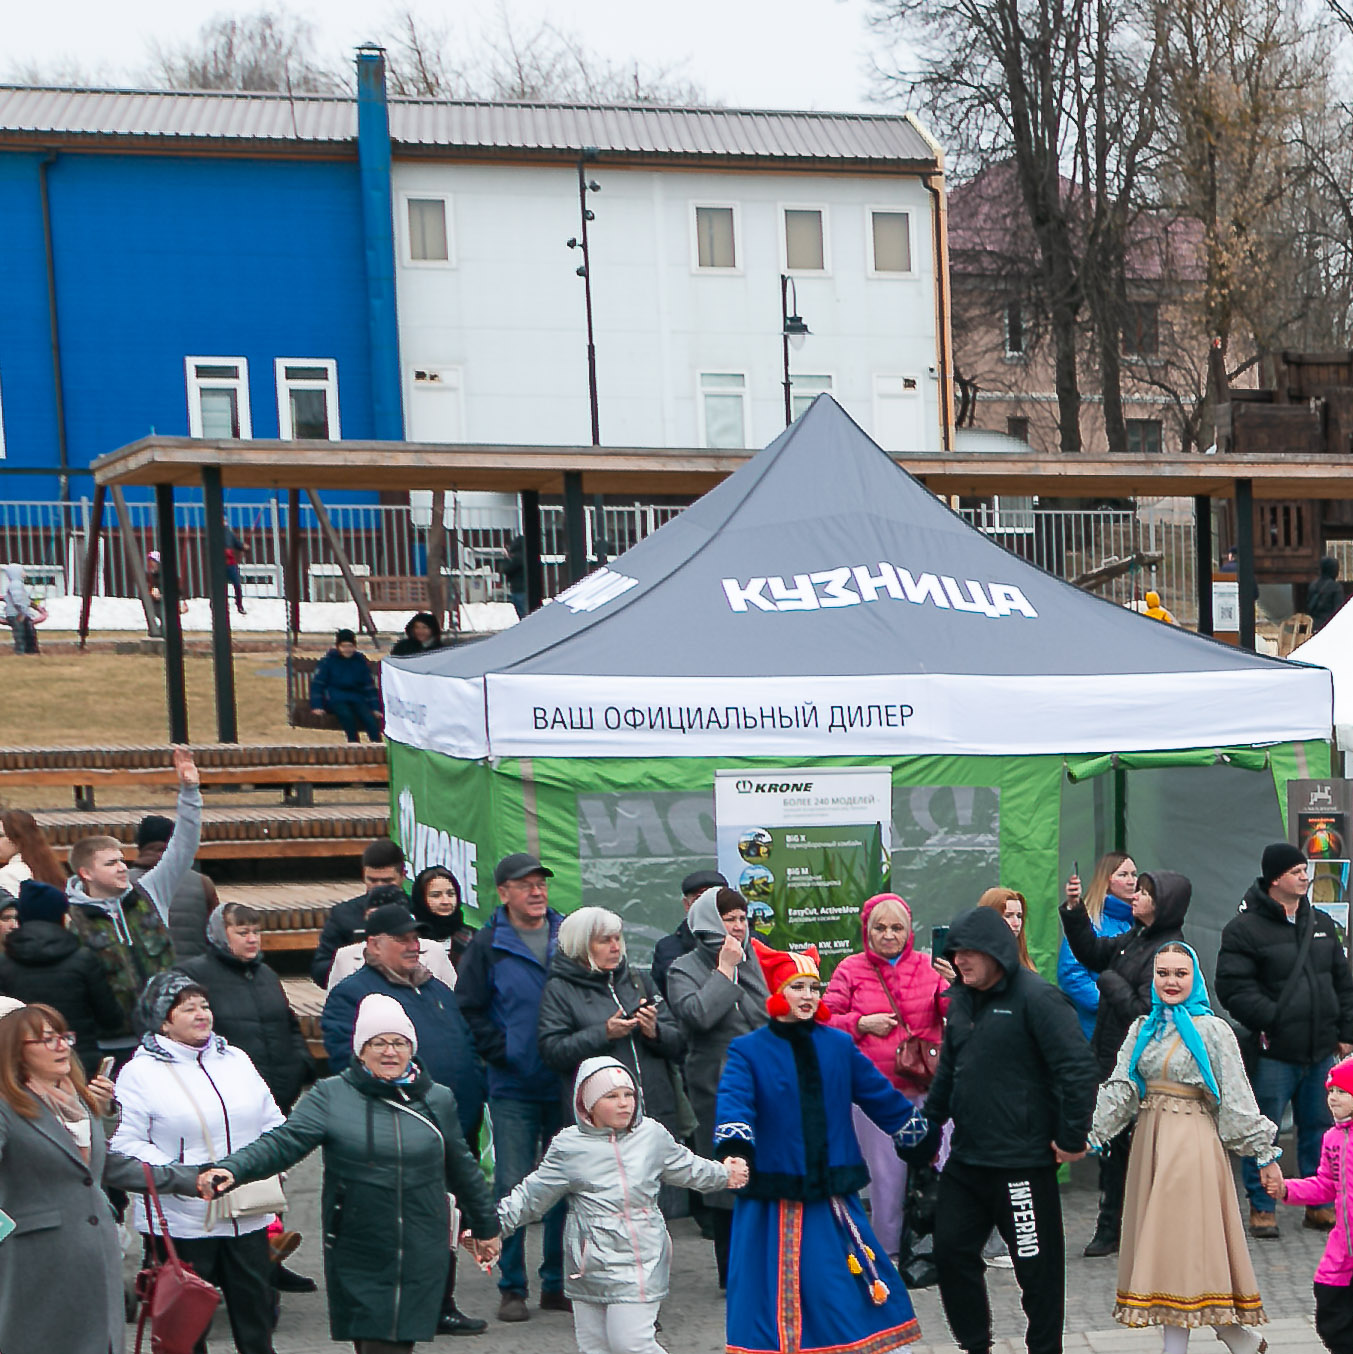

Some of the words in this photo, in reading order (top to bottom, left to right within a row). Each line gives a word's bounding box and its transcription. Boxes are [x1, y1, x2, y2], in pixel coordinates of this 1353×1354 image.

[721, 561, 1038, 618] КУЗНИЦА
[532, 706, 594, 731] ВАШ
[603, 700, 819, 734] ОФИЦИАЛЬНЫЙ
[828, 704, 915, 734] ДИЛЕР
[755, 782, 814, 793] KRONE
[783, 798, 811, 806] БОЛЕЕ
[814, 797, 830, 806] 240
[831, 793, 875, 806] МОДЕЛЕЙ
[1007, 1180, 1040, 1257] INFERNO
